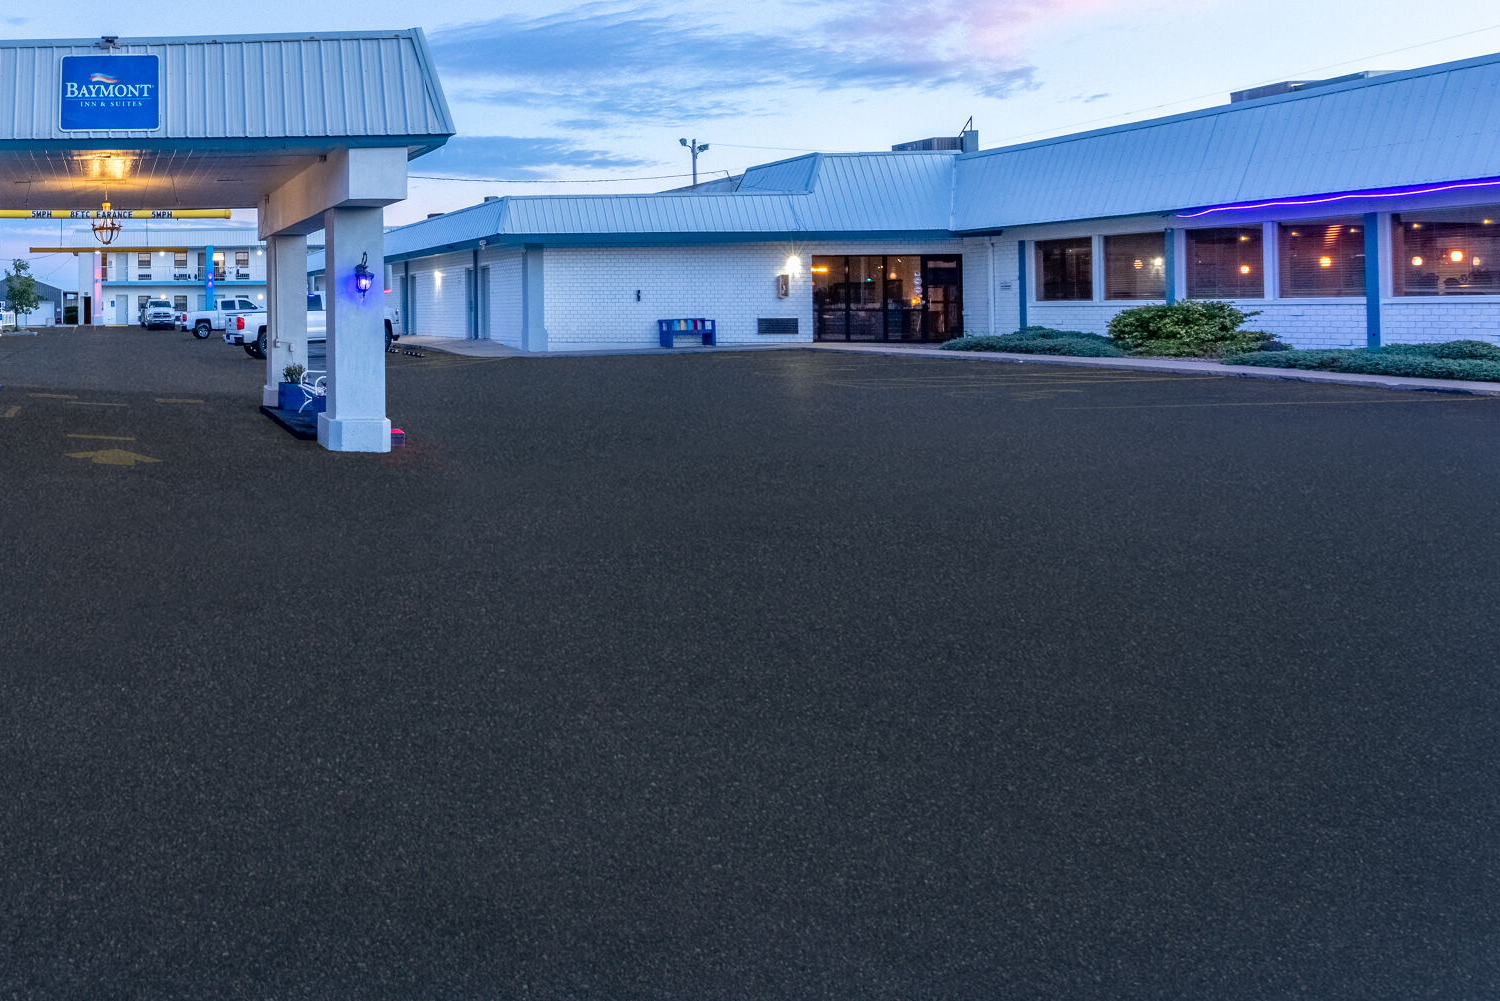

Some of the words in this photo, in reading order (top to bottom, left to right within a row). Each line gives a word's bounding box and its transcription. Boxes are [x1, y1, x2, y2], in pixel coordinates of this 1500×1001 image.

[65, 82, 152, 98] BAYMONT
[31, 211, 53, 219] 5MPH
[151, 211, 173, 219] 5MPH
